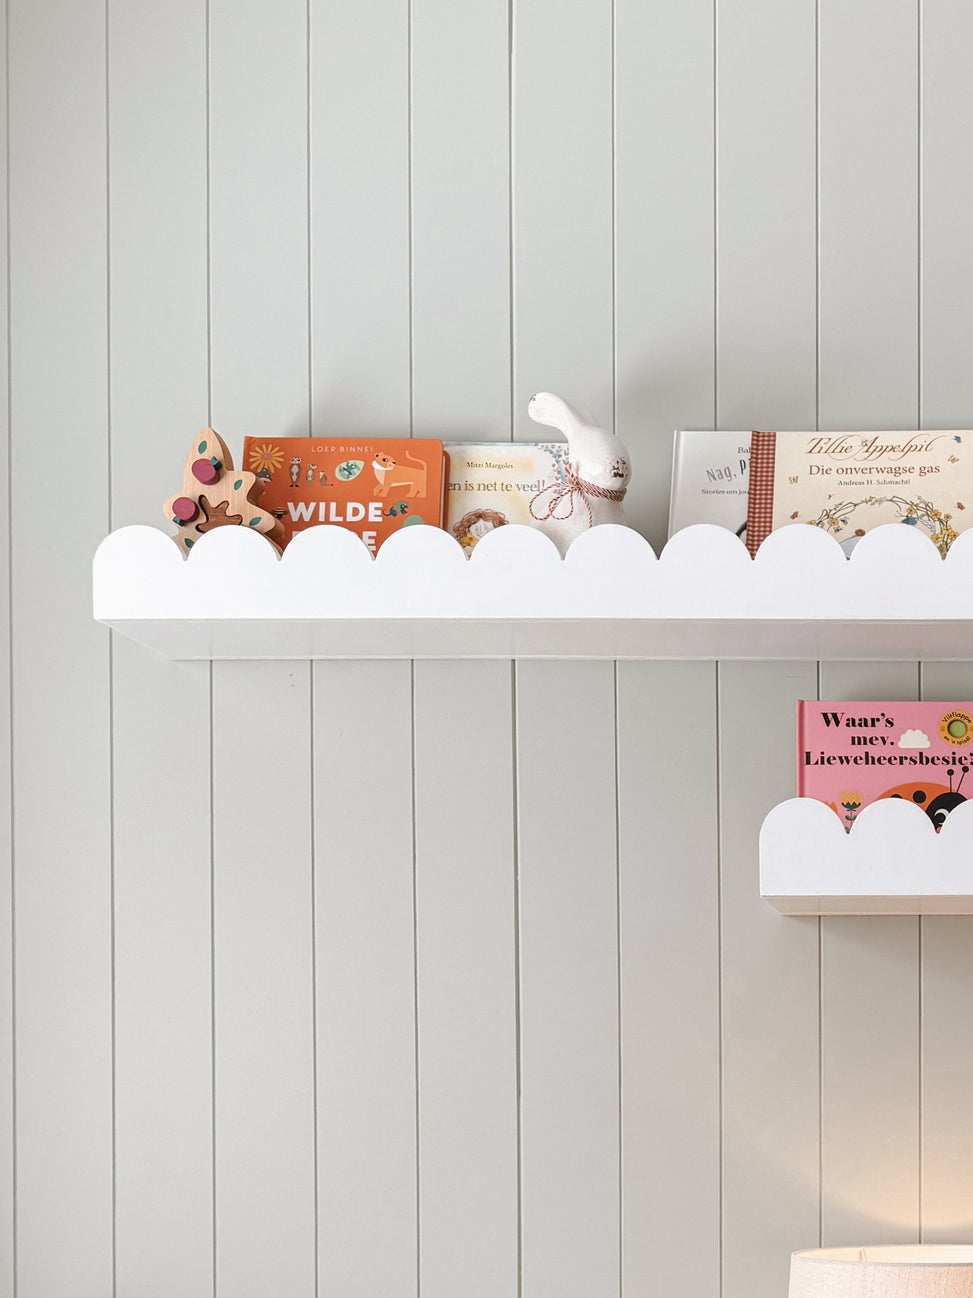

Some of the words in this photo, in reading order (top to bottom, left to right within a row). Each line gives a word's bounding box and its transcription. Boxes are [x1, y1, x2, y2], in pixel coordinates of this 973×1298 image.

[808, 464, 833, 476] Die
[836, 465, 915, 477] onverwagse
[918, 465, 941, 477] gas
[465, 480, 474, 491] is
[477, 481, 498, 491] net
[500, 481, 513, 491] te
[515, 479, 545, 492] veel!
[287, 502, 383, 522] WILDE
[821, 712, 895, 728] Waar's
[850, 736, 895, 746] mev.
